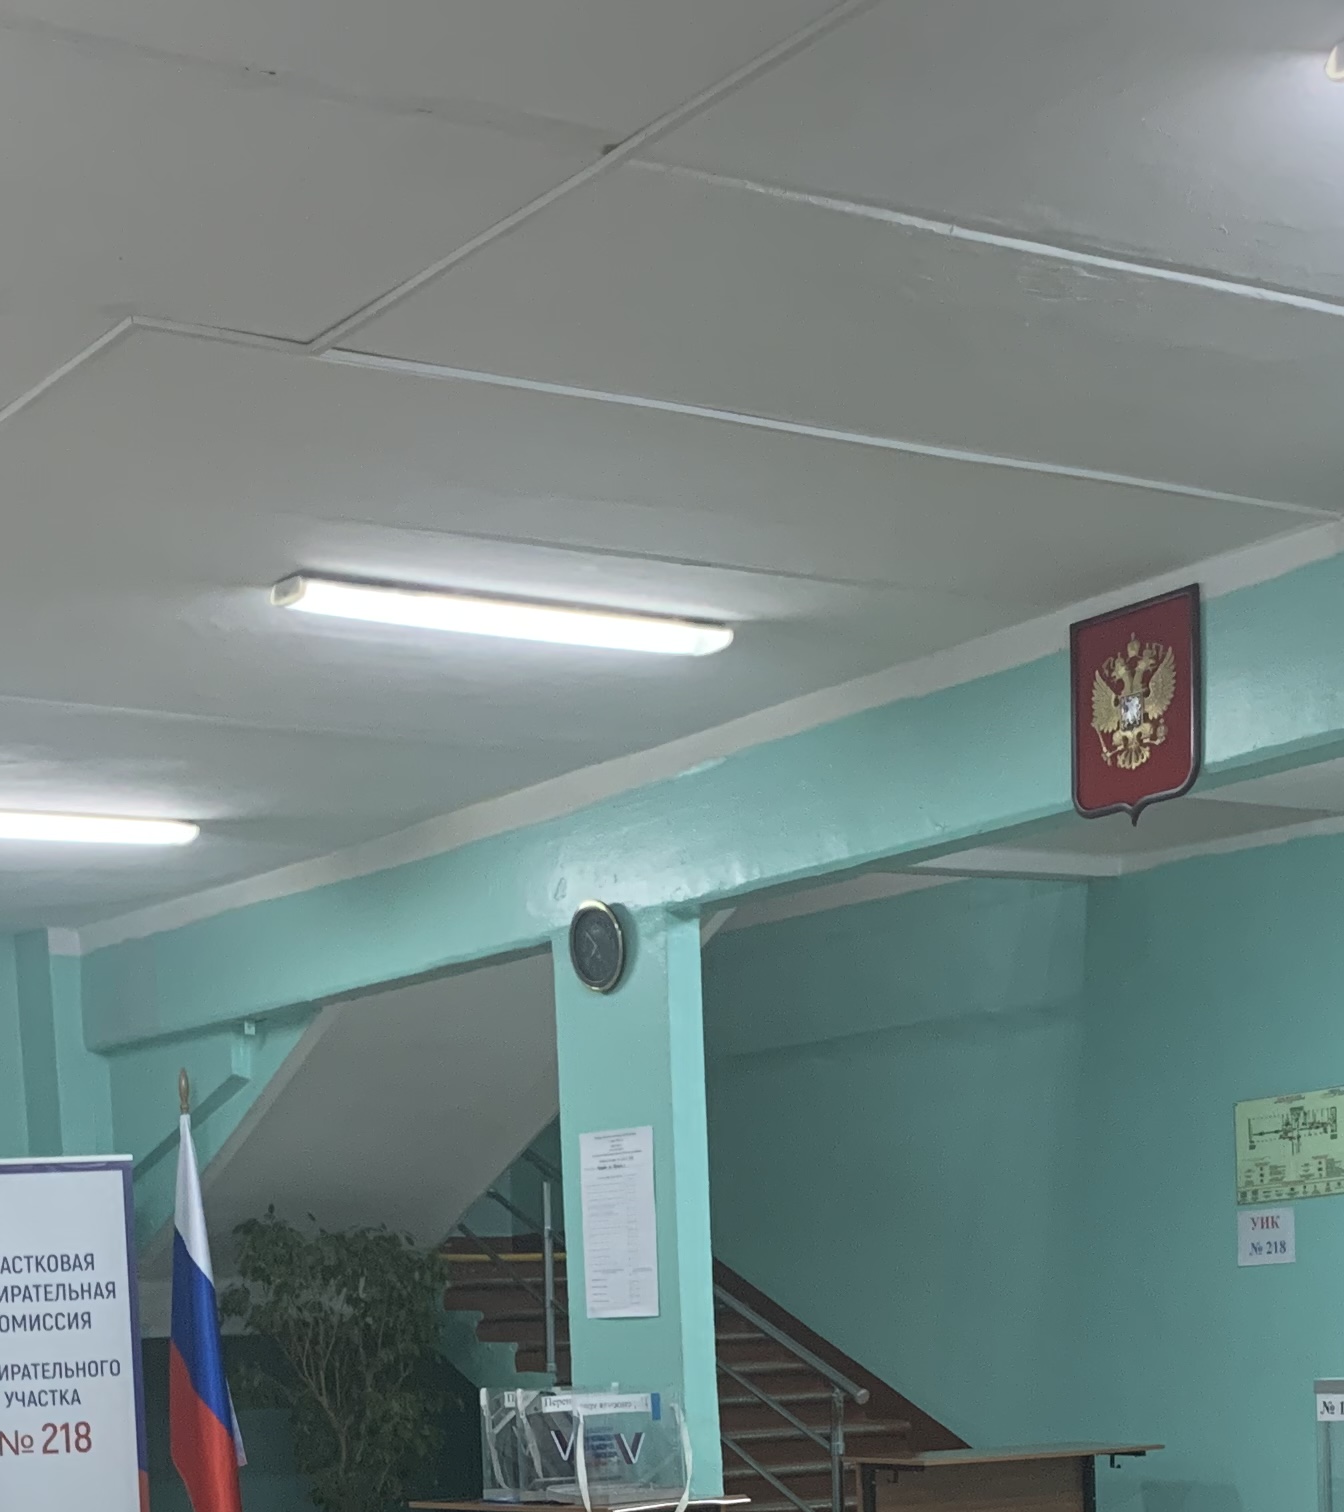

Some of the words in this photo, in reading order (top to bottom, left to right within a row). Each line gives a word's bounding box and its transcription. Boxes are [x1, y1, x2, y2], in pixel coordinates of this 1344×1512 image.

[1250, 1215, 1280, 1231] УИК
[1249, 1241, 1263, 1256] №
[1266, 1240, 1287, 1254] 218
[4, 1388, 82, 1408] УЧАСТКА
[1320, 1401, 1336, 1415] №
[1339, 1401, 1344, 1415] 1
[41, 1421, 93, 1454] 218
